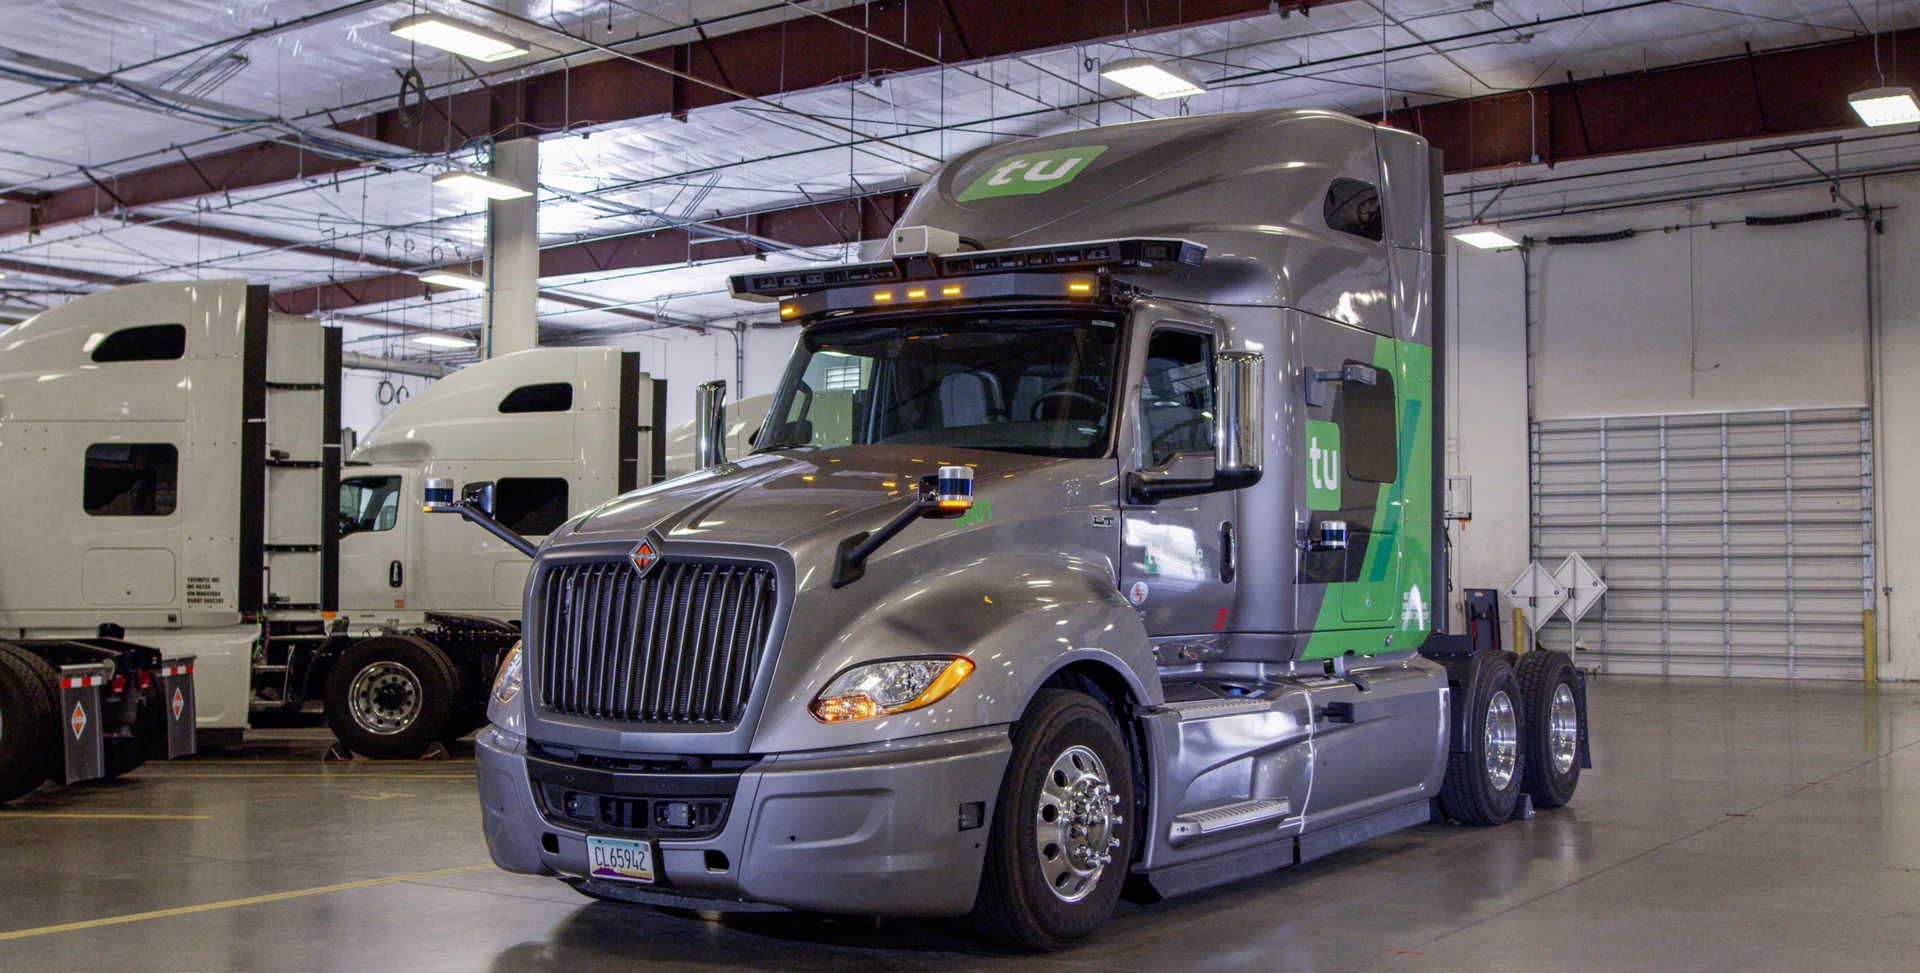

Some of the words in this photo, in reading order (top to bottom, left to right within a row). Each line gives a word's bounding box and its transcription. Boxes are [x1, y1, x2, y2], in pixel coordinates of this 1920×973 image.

[988, 157, 1083, 186] tu
[1309, 436, 1338, 490] tu
[1093, 516, 1115, 526] LT
[595, 847, 646, 871] CL65942
